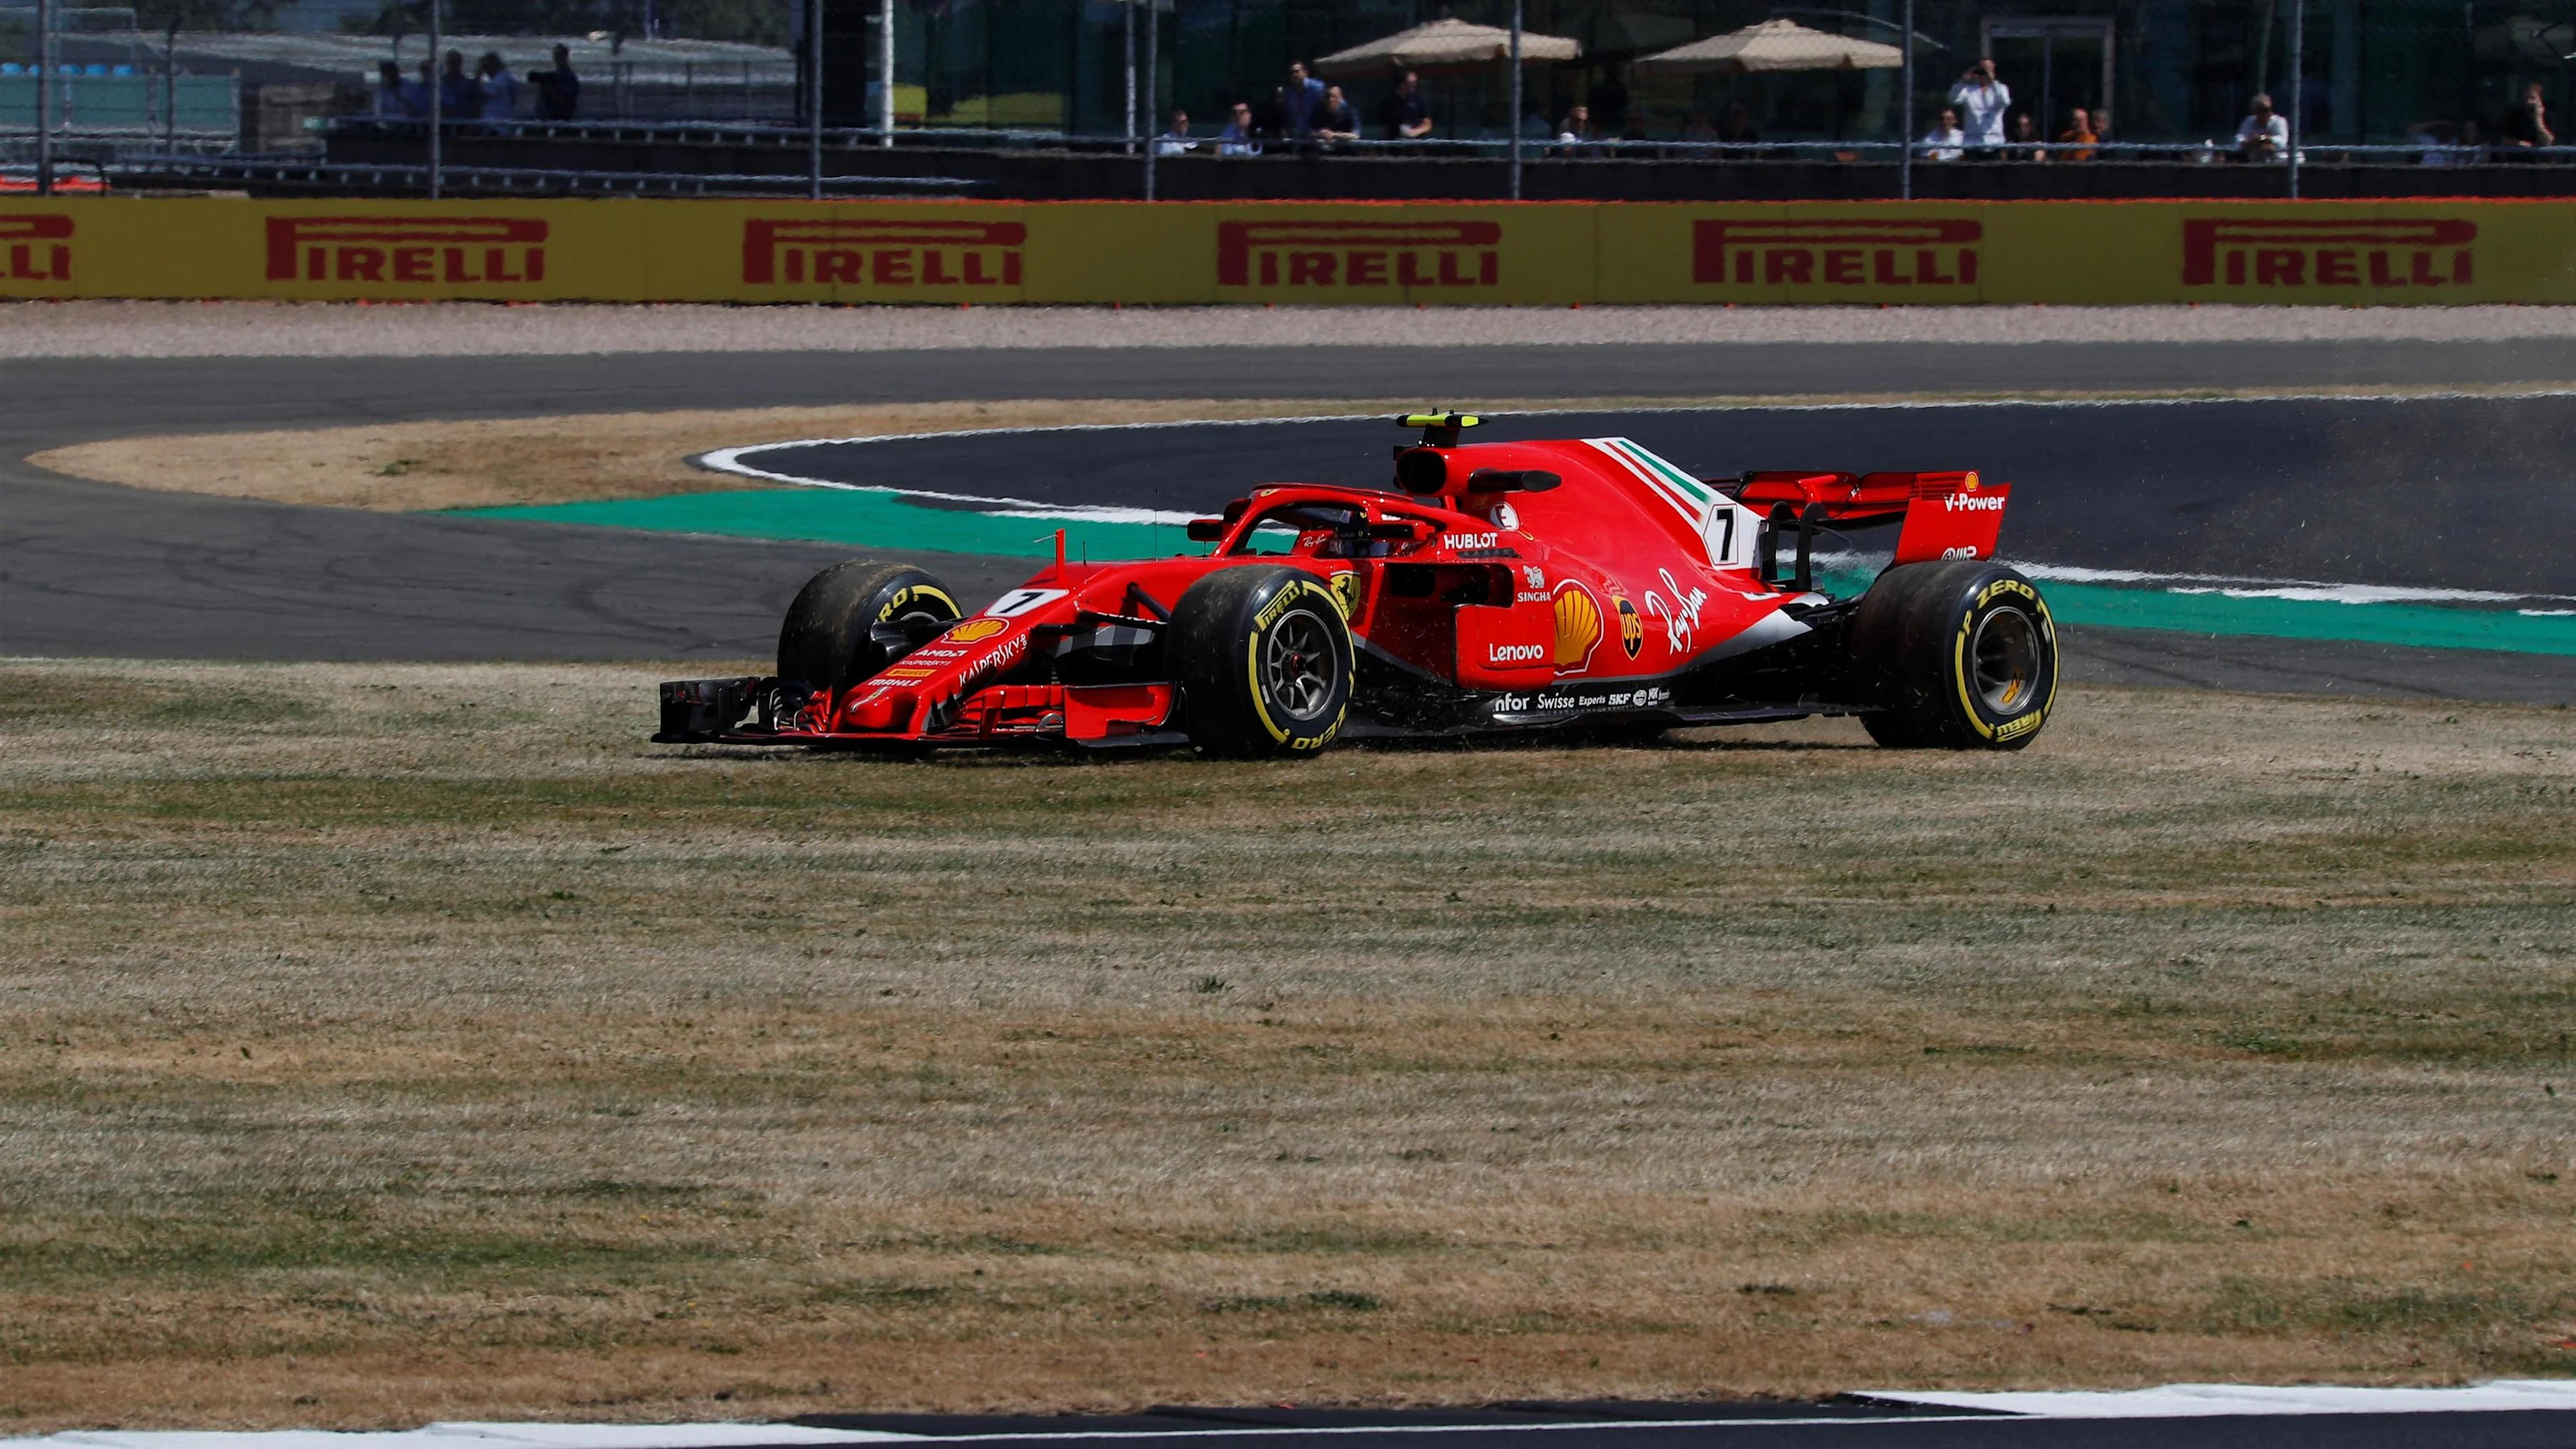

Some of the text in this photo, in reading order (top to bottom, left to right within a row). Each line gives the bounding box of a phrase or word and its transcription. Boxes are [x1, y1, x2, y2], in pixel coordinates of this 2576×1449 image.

[266, 216, 548, 282] PIRELLI
[744, 219, 1027, 284] PIRELLI
[1219, 220, 1501, 286] PIRELLI
[1693, 218, 1982, 285] PIRELLI
[2182, 218, 2477, 287] PIRELLI
[1943, 493, 2005, 512] V-Power
[1443, 532, 1498, 550] HUBLOT
[1715, 508, 1734, 561] 7
[998, 592, 1046, 613] 7
[1253, 579, 1301, 632] PIRELLI
[1517, 591, 1551, 603] SINGHA
[1976, 579, 2036, 610] ZERO
[914, 649, 953, 658] AMD
[1489, 642, 1544, 662] Lenovo
[868, 679, 923, 687] MAHLE
[1537, 691, 1575, 710] Swisse
[1578, 694, 1607, 708] Experis
[1608, 692, 1631, 706] SKF
[1291, 702, 1347, 750] ZERO
[1996, 708, 2043, 743] PIRELLI
